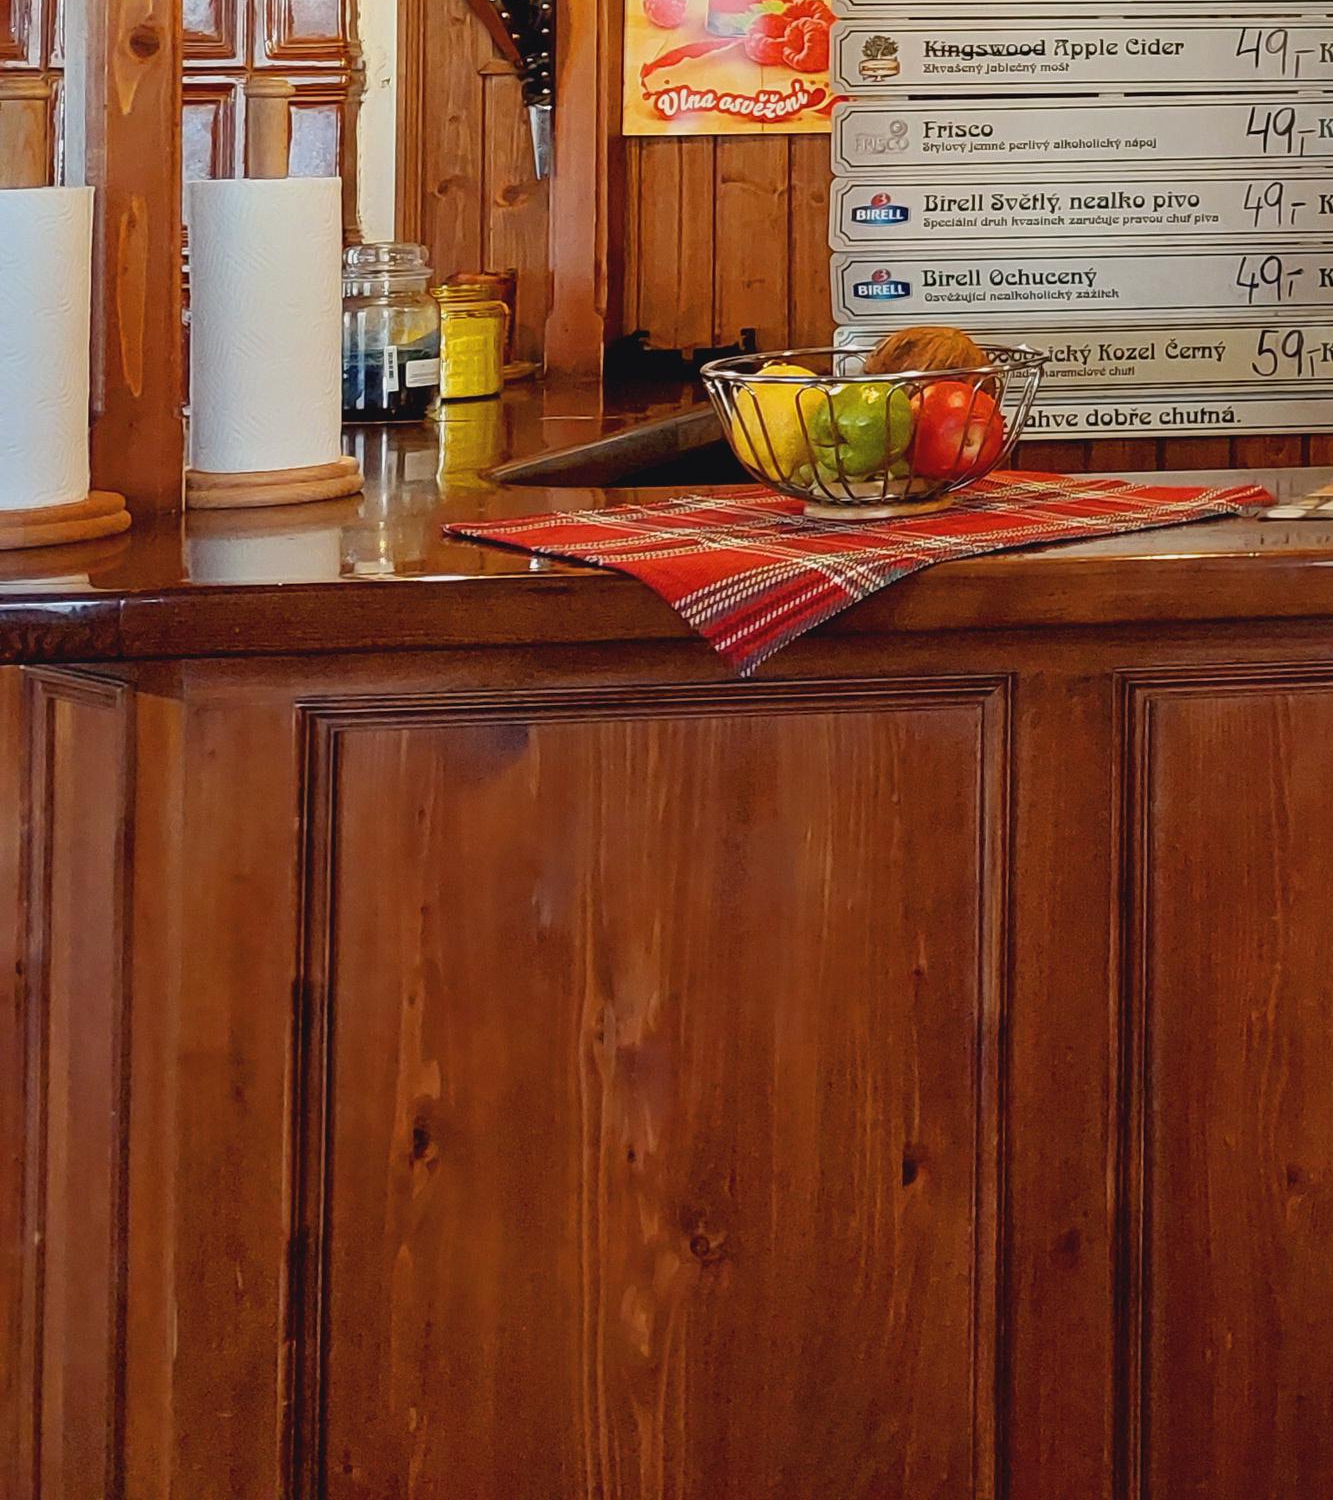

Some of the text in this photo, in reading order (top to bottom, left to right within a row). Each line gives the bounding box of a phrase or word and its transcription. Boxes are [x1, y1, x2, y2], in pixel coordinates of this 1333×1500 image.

[923, 38, 1184, 61] Kingswood Apple Cider
[923, 62, 1069, 76] Zkvašený jablečný mošt
[657, 82, 808, 118] Vlna osvěžení
[923, 121, 994, 139] Frisco
[922, 141, 966, 153] Stylový
[1009, 140, 1050, 152] perlivý
[1053, 138, 1121, 151] alkoholický
[1125, 138, 1157, 149] nápoj
[923, 194, 984, 212] Birell
[1069, 192, 1145, 210] nealko
[1153, 192, 1200, 212] pivo
[856, 209, 904, 221] BIRELL
[923, 216, 978, 228] Speciální
[981, 216, 1008, 227] druh
[1011, 215, 1065, 227] kvasinek
[1068, 214, 1119, 227] zaručuje
[1122, 215, 1163, 226] pravou
[1194, 213, 1219, 224] piva
[922, 267, 1097, 289] Birell Ochucený
[858, 284, 905, 297] BIRELL
[924, 288, 1120, 303] Osvěžující nealkoholický zážitek
[1098, 343, 1155, 361] Kozel
[1165, 338, 1226, 362] Černý
[1022, 409, 1079, 428] ahve
[1085, 407, 1152, 427] dobře
[1160, 406, 1241, 425] chutná.
